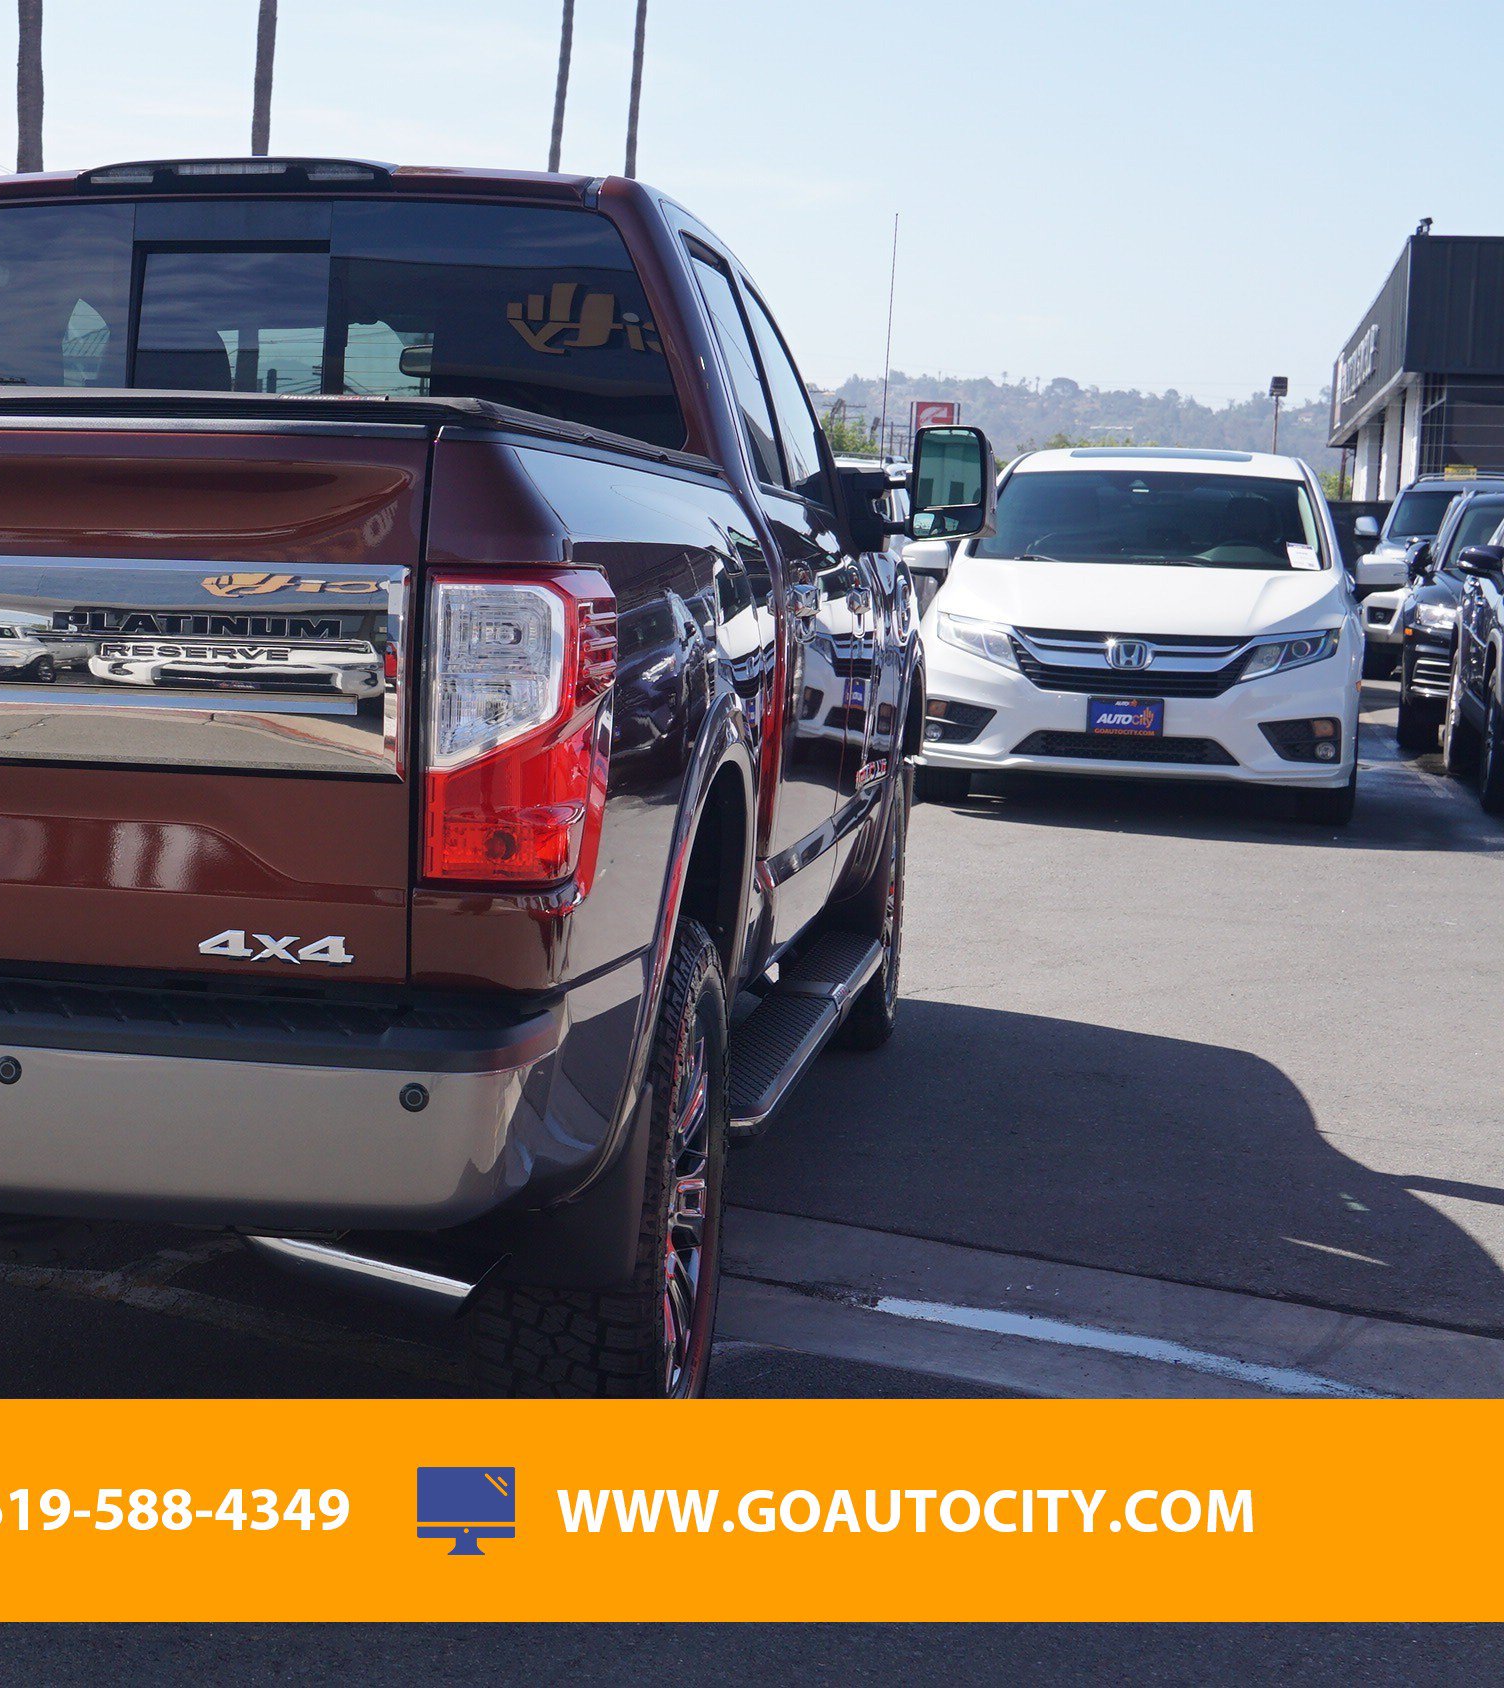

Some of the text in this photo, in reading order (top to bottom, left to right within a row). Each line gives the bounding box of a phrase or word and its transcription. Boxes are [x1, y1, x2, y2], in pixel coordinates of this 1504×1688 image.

[52, 611, 343, 639] PLATINUM
[101, 643, 291, 662] RESERVE
[1094, 728, 1155, 736] GOAUTOCITY.COM
